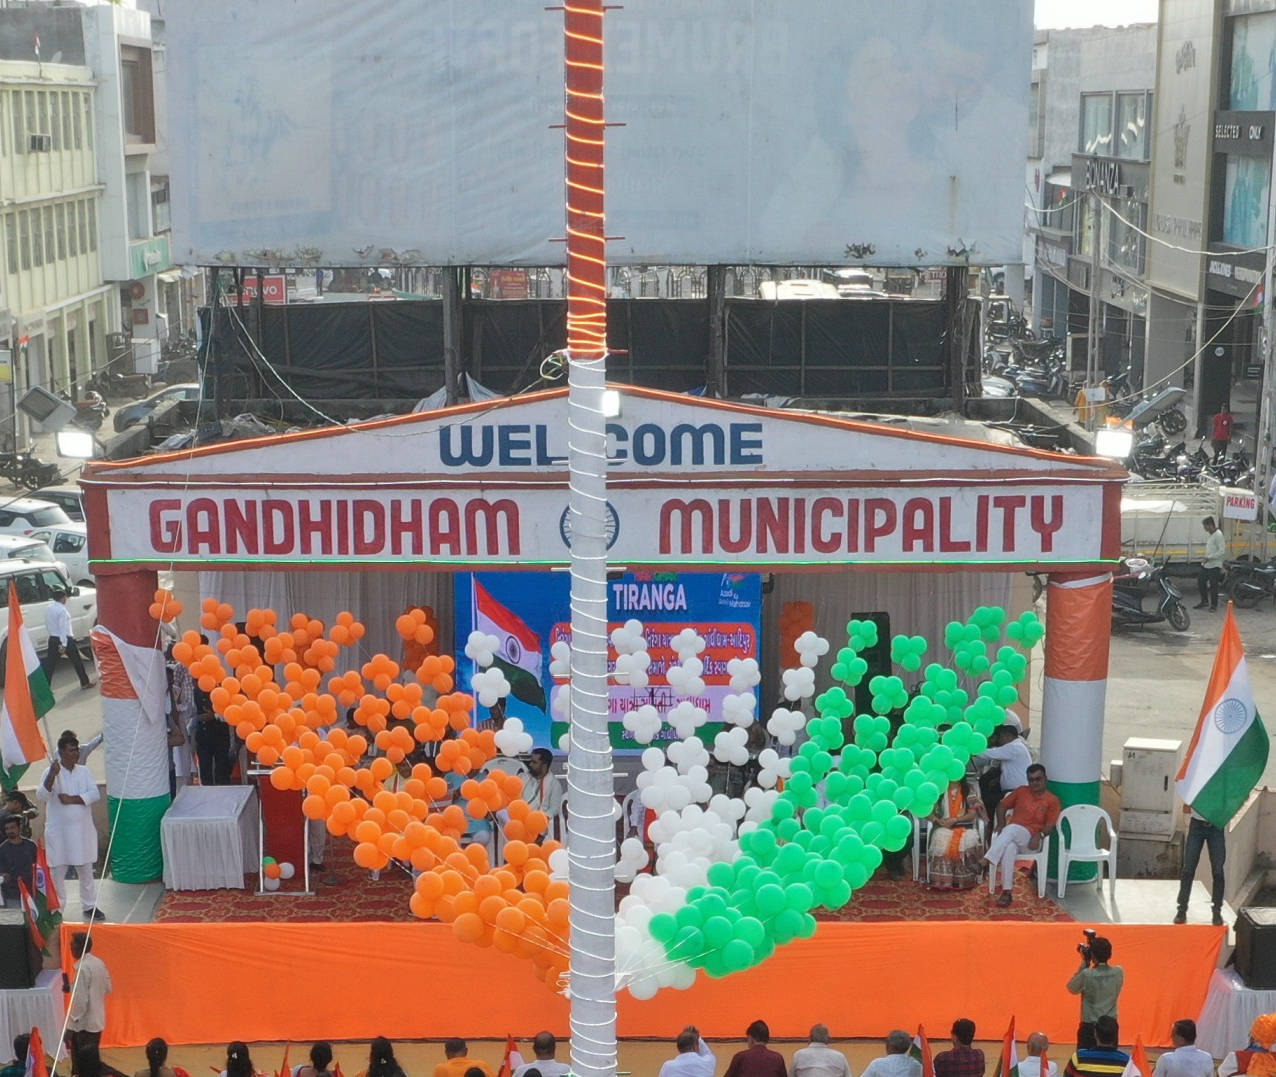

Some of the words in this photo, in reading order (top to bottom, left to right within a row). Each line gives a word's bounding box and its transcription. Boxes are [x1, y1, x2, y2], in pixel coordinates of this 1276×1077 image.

[1215, 124, 1240, 139] SELECTED
[439, 423, 763, 466] WELCOME
[1226, 495, 1256, 510] PARKING
[149, 497, 521, 556] GANDHIDHAM
[659, 494, 1064, 556] MUNICIPALITY
[613, 583, 687, 611] TIRANGA
